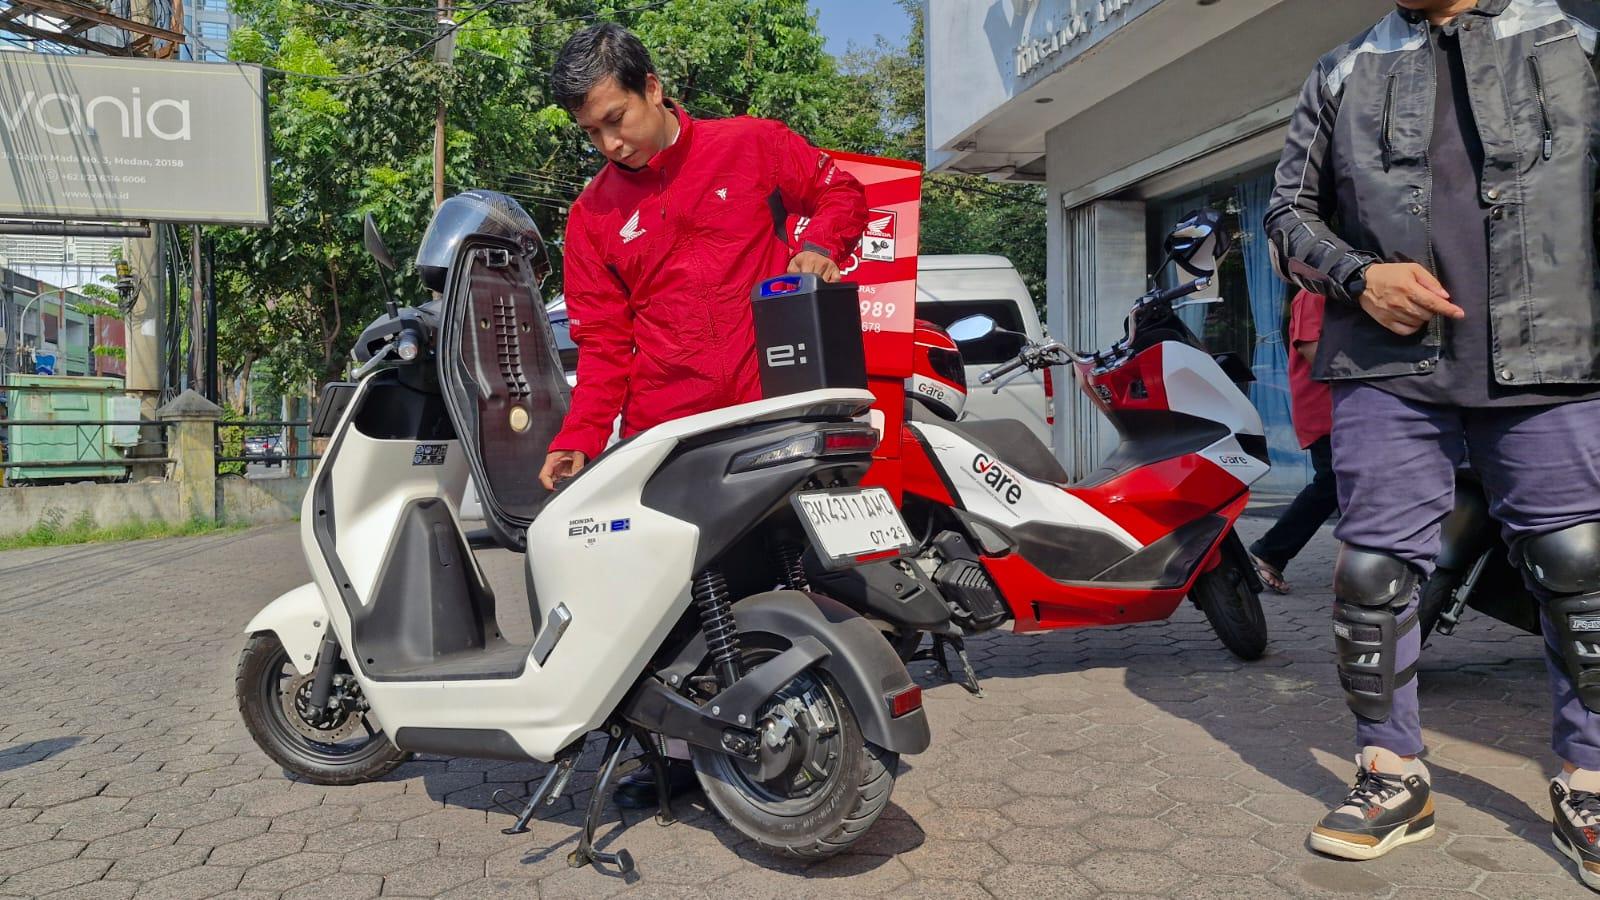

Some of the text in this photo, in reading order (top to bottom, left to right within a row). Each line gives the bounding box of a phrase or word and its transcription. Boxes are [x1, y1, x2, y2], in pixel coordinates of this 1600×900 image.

[0, 87, 191, 141] vania
[114, 157, 153, 168] Medan,
[155, 158, 184, 168] 20158
[122, 175, 147, 184] 6006
[623, 228, 646, 244] HONDA
[866, 230, 892, 238] HONDA
[569, 517, 594, 525] HONDA
[568, 523, 607, 536] EM1
